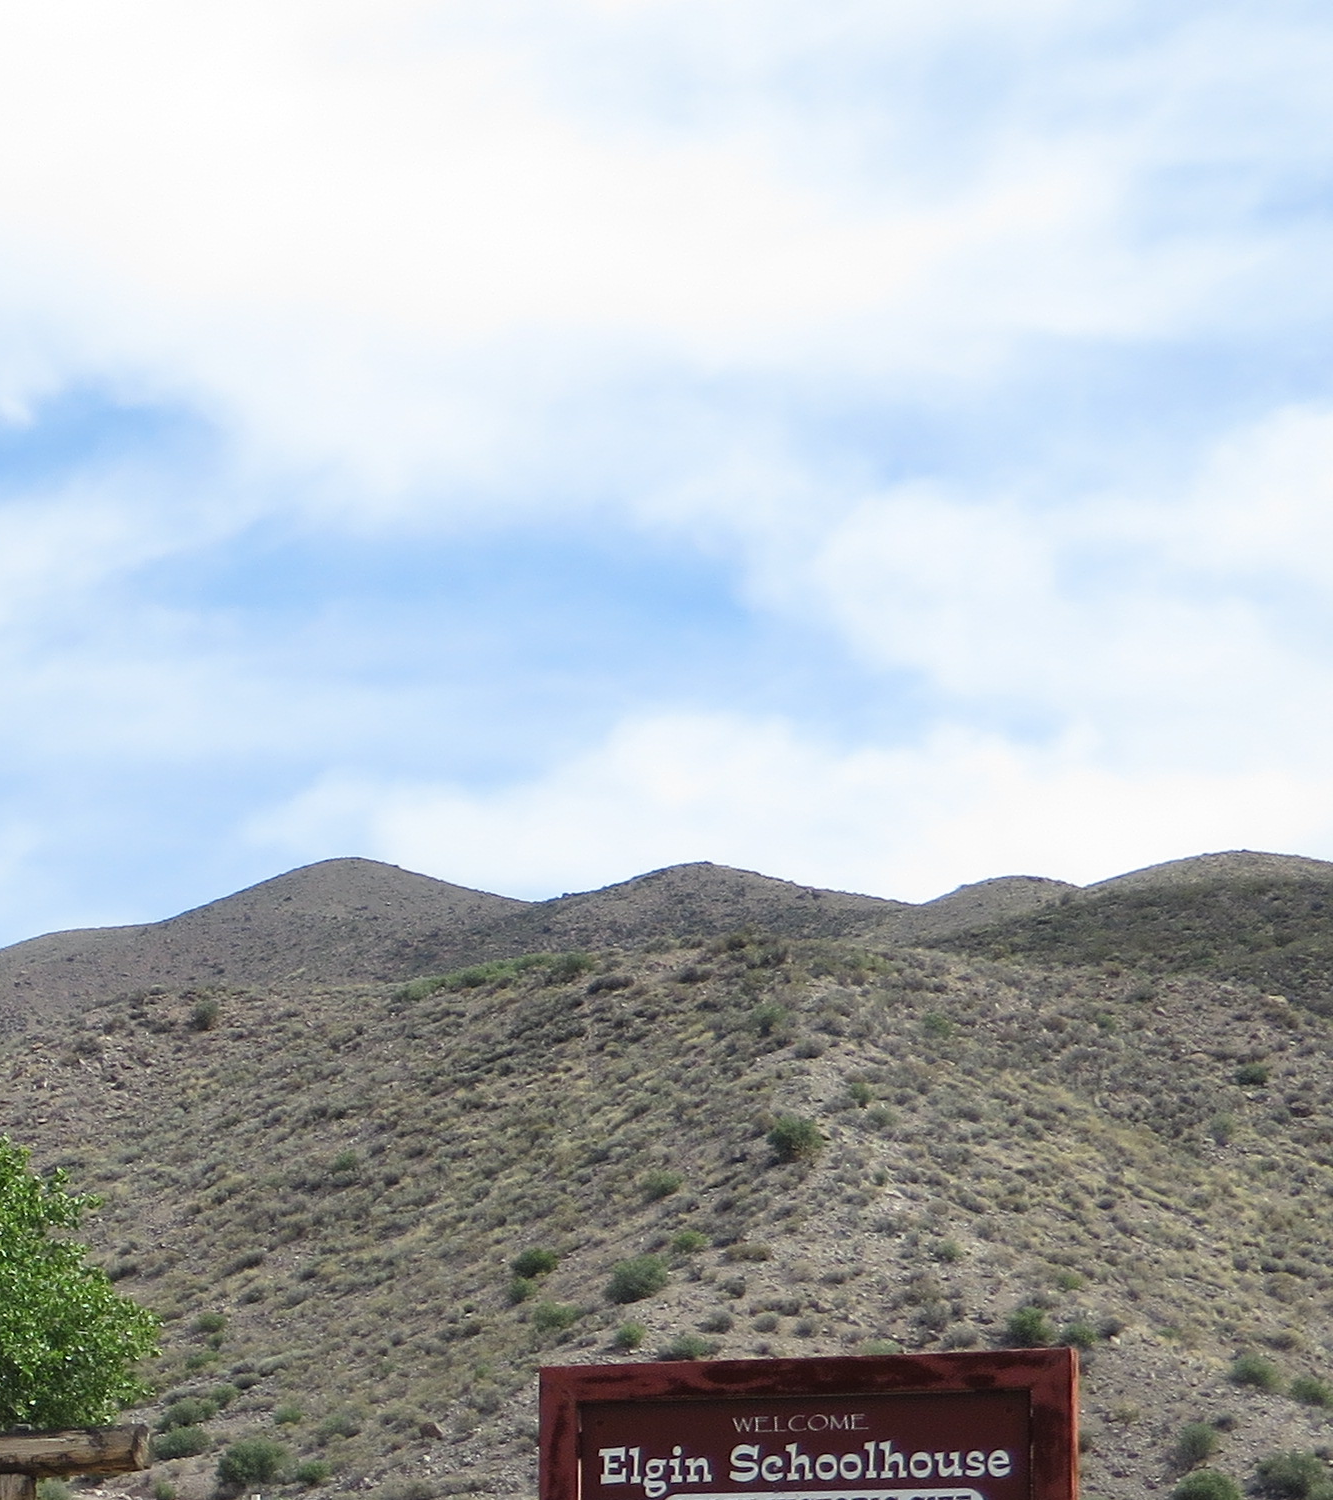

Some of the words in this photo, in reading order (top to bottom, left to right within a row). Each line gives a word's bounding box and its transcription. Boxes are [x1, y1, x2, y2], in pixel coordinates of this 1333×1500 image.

[733, 1413, 870, 1433] WELCOME
[598, 1446, 714, 1498] Elgin
[729, 1440, 1012, 1483] Schoolhouse
